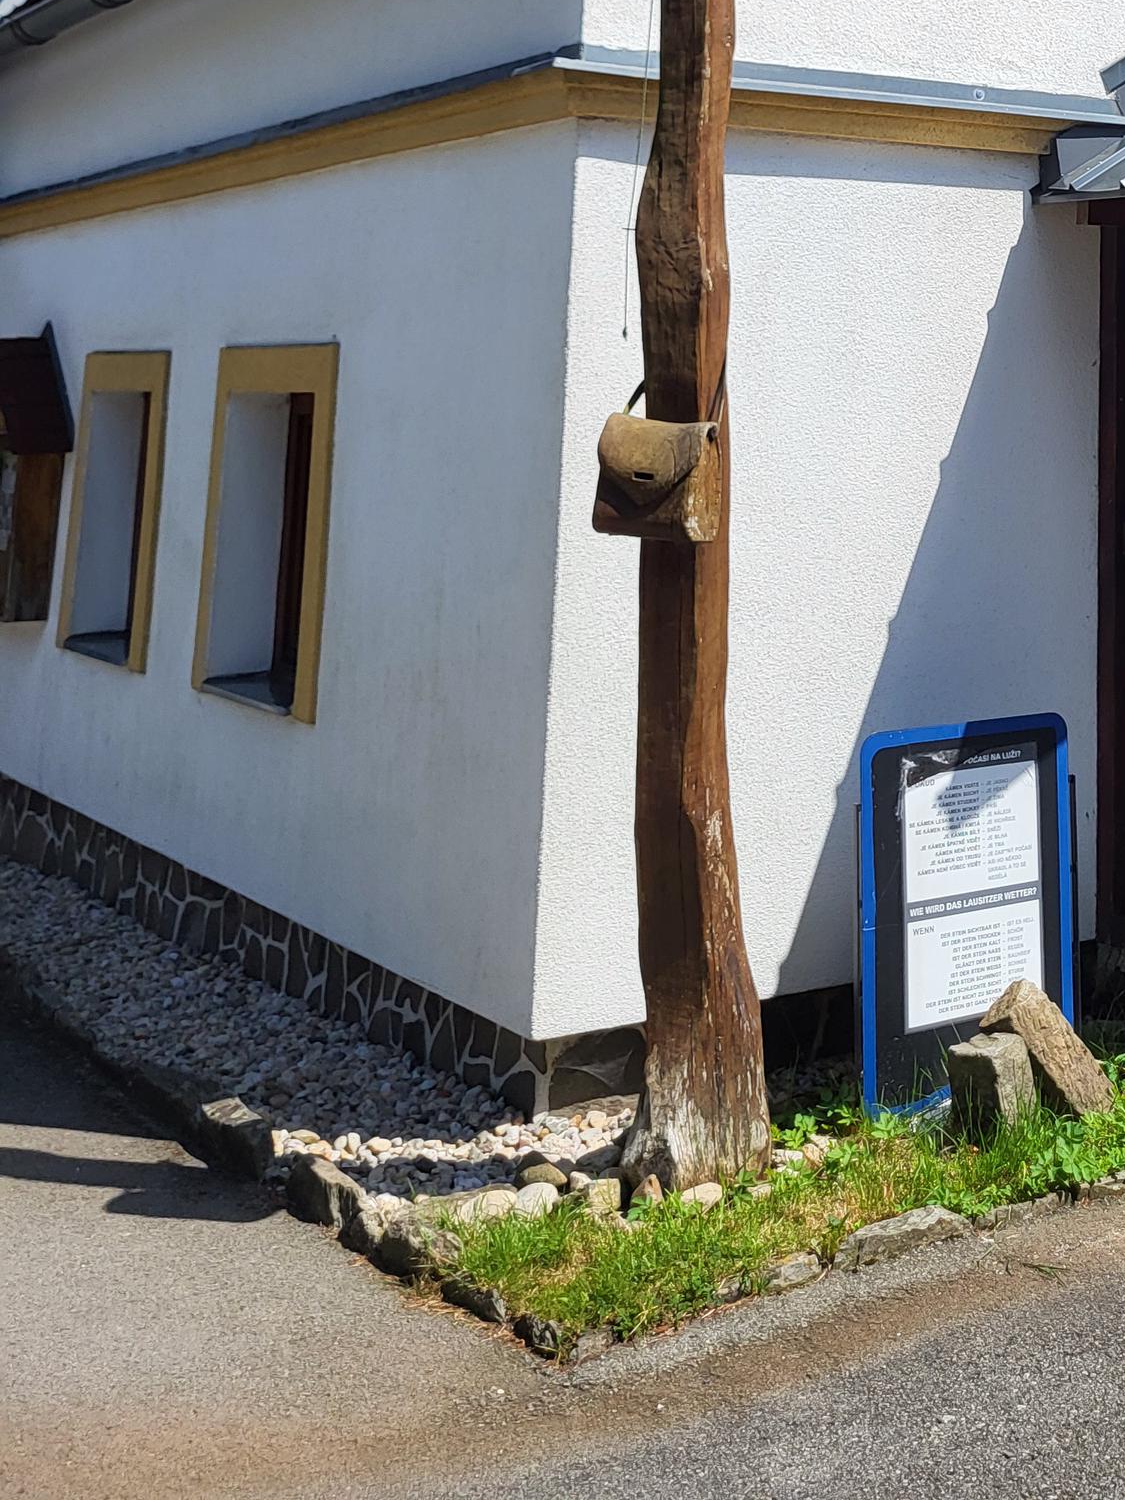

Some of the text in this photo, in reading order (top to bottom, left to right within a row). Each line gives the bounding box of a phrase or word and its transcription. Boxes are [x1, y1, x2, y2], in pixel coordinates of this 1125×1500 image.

[991, 752, 1000, 761] NA
[910, 887, 1037, 917] WIE WIRD DAS LAUSITZER WETTER?
[913, 925, 935, 936] WENN
